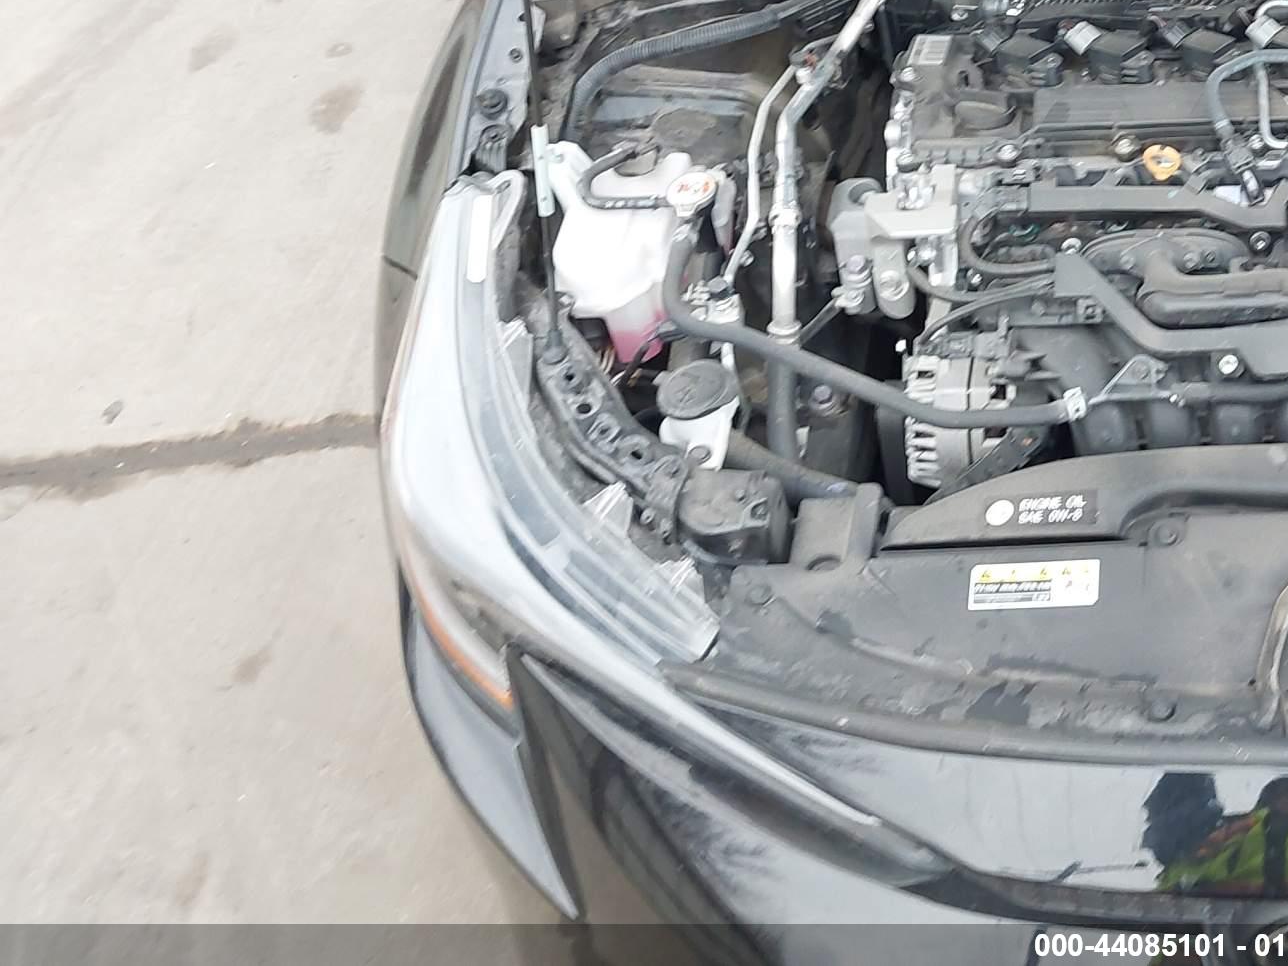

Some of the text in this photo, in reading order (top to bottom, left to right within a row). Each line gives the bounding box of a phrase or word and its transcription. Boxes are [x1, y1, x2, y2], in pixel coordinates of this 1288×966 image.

[1018, 494, 1087, 511] ENGINE OIL
[1018, 510, 1044, 524] SAE
